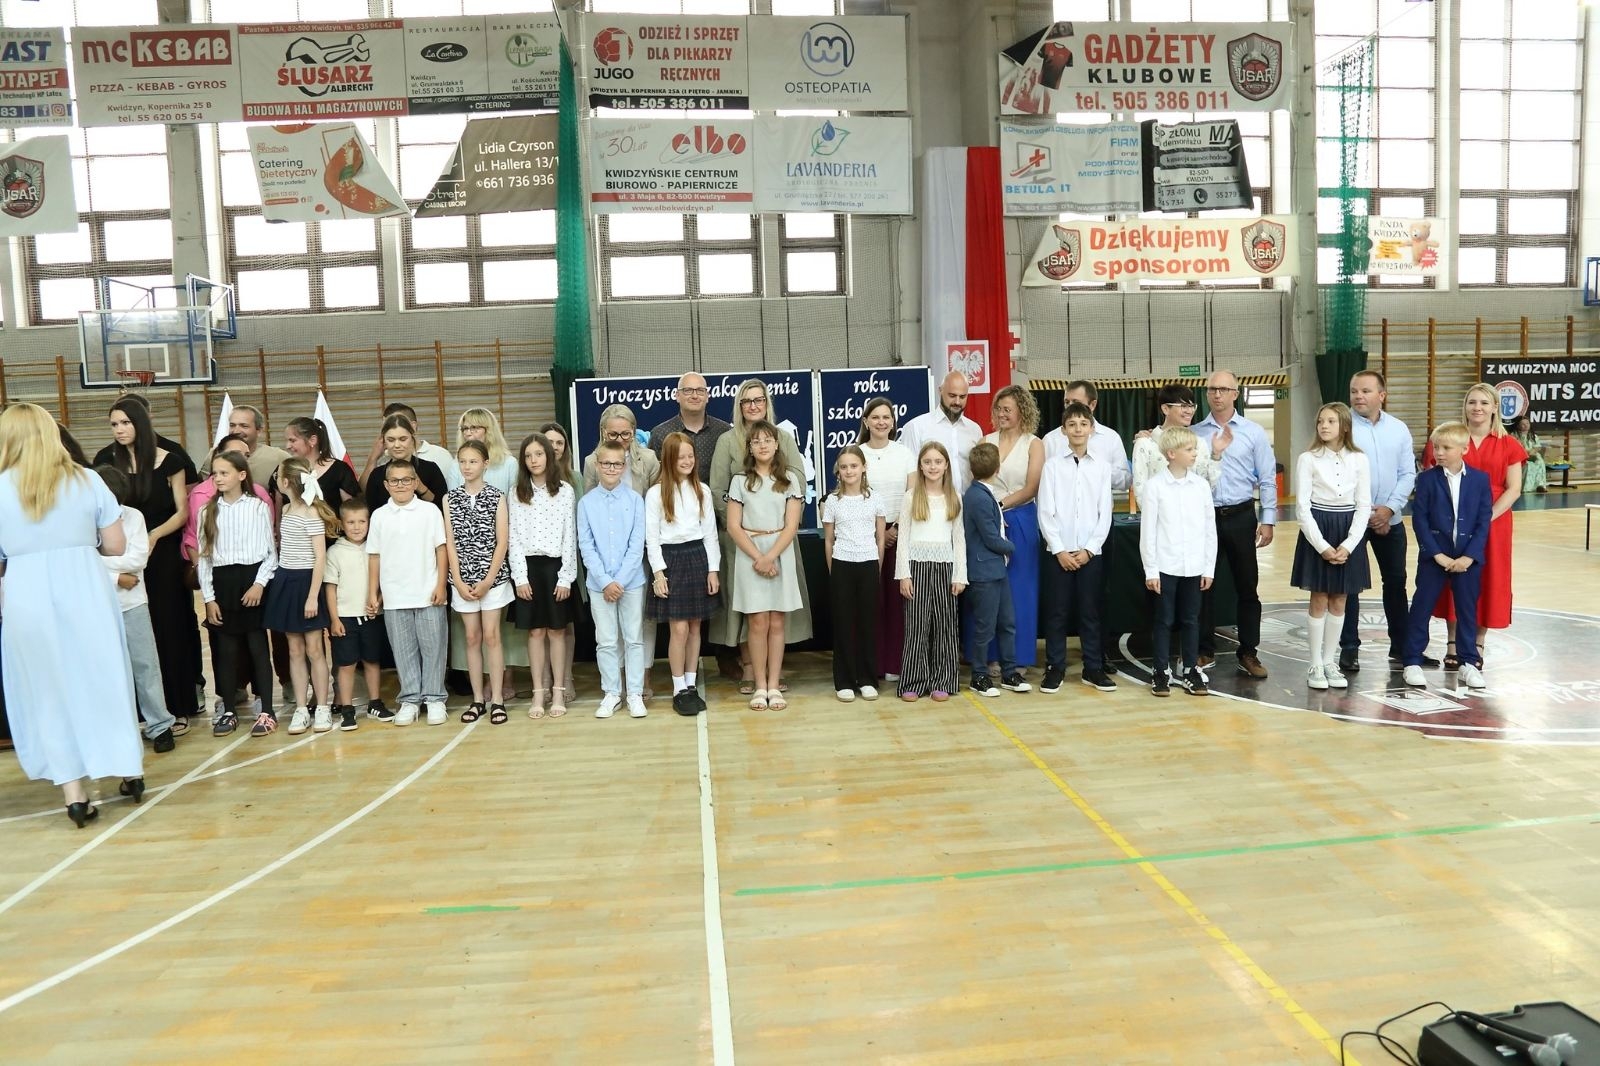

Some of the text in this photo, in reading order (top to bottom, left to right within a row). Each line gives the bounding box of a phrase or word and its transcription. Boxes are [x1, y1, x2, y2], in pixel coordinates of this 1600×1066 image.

[639, 24, 740, 42] ODZIEŻ I SPRZĘT
[0, 41, 51, 62] AST
[137, 37, 230, 62] KEBAB
[1084, 27, 1216, 64] GADŻETY
[647, 47, 732, 60] DLA PIŁKARZY
[277, 63, 373, 86] ŚLUSARZ
[594, 68, 634, 79] JUGO
[660, 67, 720, 82] RĘCZNYCH
[1088, 68, 1212, 83] KLUBOWE
[1237, 67, 1274, 83] USAR
[90, 84, 125, 93] PIZZA
[137, 82, 175, 92] KEBAB
[187, 80, 227, 90] GYROS
[331, 84, 374, 93] ALBRECHT
[784, 82, 872, 94] OSTEOPATIA
[107, 103, 146, 113] Kwidzyn,
[148, 102, 191, 112] Kopernika
[193, 101, 203, 109] 25
[475, 101, 511, 110] CETERING
[612, 97, 724, 109] tel. 505 386 011
[1075, 91, 1229, 110] tel. 505 386 011
[247, 101, 403, 116] BUDOWA HAL MAGAZYNOWYCH
[118, 114, 135, 123] tel.
[137, 114, 150, 122] 55
[153, 113, 172, 121] 620
[190, 112, 203, 120] 54
[671, 125, 746, 155] elbo
[1110, 138, 1139, 148] FIRM
[479, 141, 554, 155] Lidia Czyrson
[259, 158, 303, 169] Catering
[474, 163, 487, 172] ul.
[491, 158, 531, 171] Hallera
[786, 162, 877, 178] LAVANDERIA
[260, 168, 317, 179] Dietetyczny
[605, 167, 738, 178] KWIDZYŃSKIE CENTRUM
[484, 174, 555, 189] 661 736 936
[606, 181, 657, 190] BIUROWO
[667, 181, 738, 190] PAPIERNICZE
[1005, 183, 1072, 194] BETULA IT
[2, 186, 39, 202] USAR
[694, 193, 726, 201] Kwidzyn
[632, 204, 714, 212] www.elbokwidzyn.pl
[1090, 224, 1230, 253] Dziękujemy
[1042, 253, 1076, 267] USAR
[1250, 247, 1279, 260] USAR
[1093, 257, 1230, 280] sponsorom
[1486, 362, 1597, 374] Z KWIDZYNA MOC
[853, 372, 890, 394] roku
[1530, 383, 1575, 401] MTS
[1530, 410, 1557, 423] NIE
